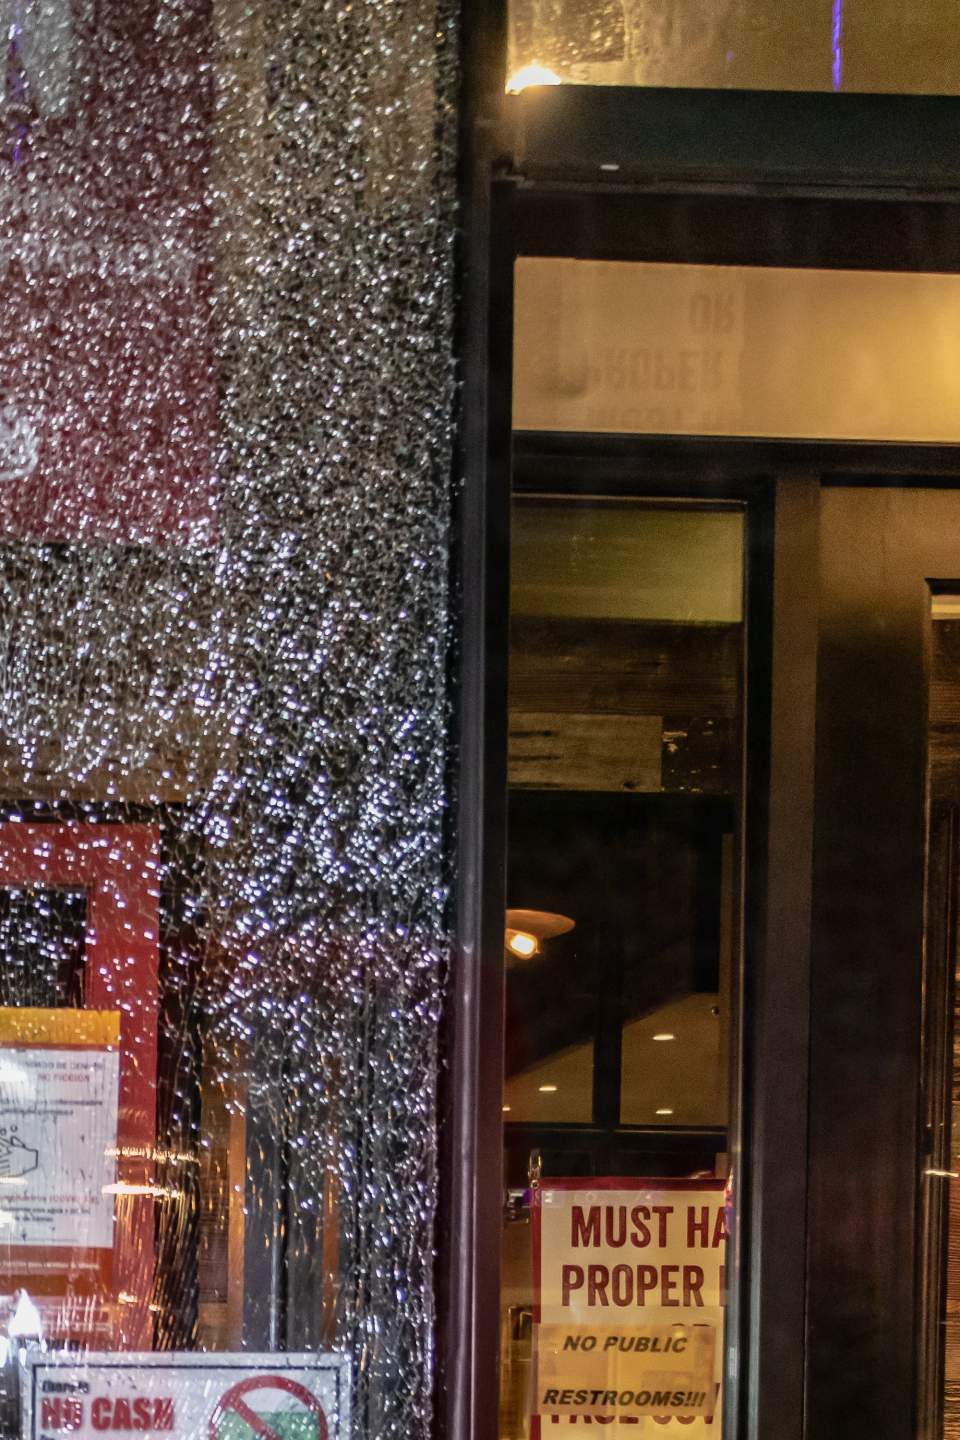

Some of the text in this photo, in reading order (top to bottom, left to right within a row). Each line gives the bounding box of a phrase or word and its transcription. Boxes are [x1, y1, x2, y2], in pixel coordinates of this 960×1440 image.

[571, 1205, 674, 1248] MUST
[561, 1264, 705, 1308] PROPER
[563, 1335, 688, 1352] NO PUBLIC
[41, 1397, 175, 1431] NO CASH
[542, 1389, 707, 1407] RESTROOMS!!!
